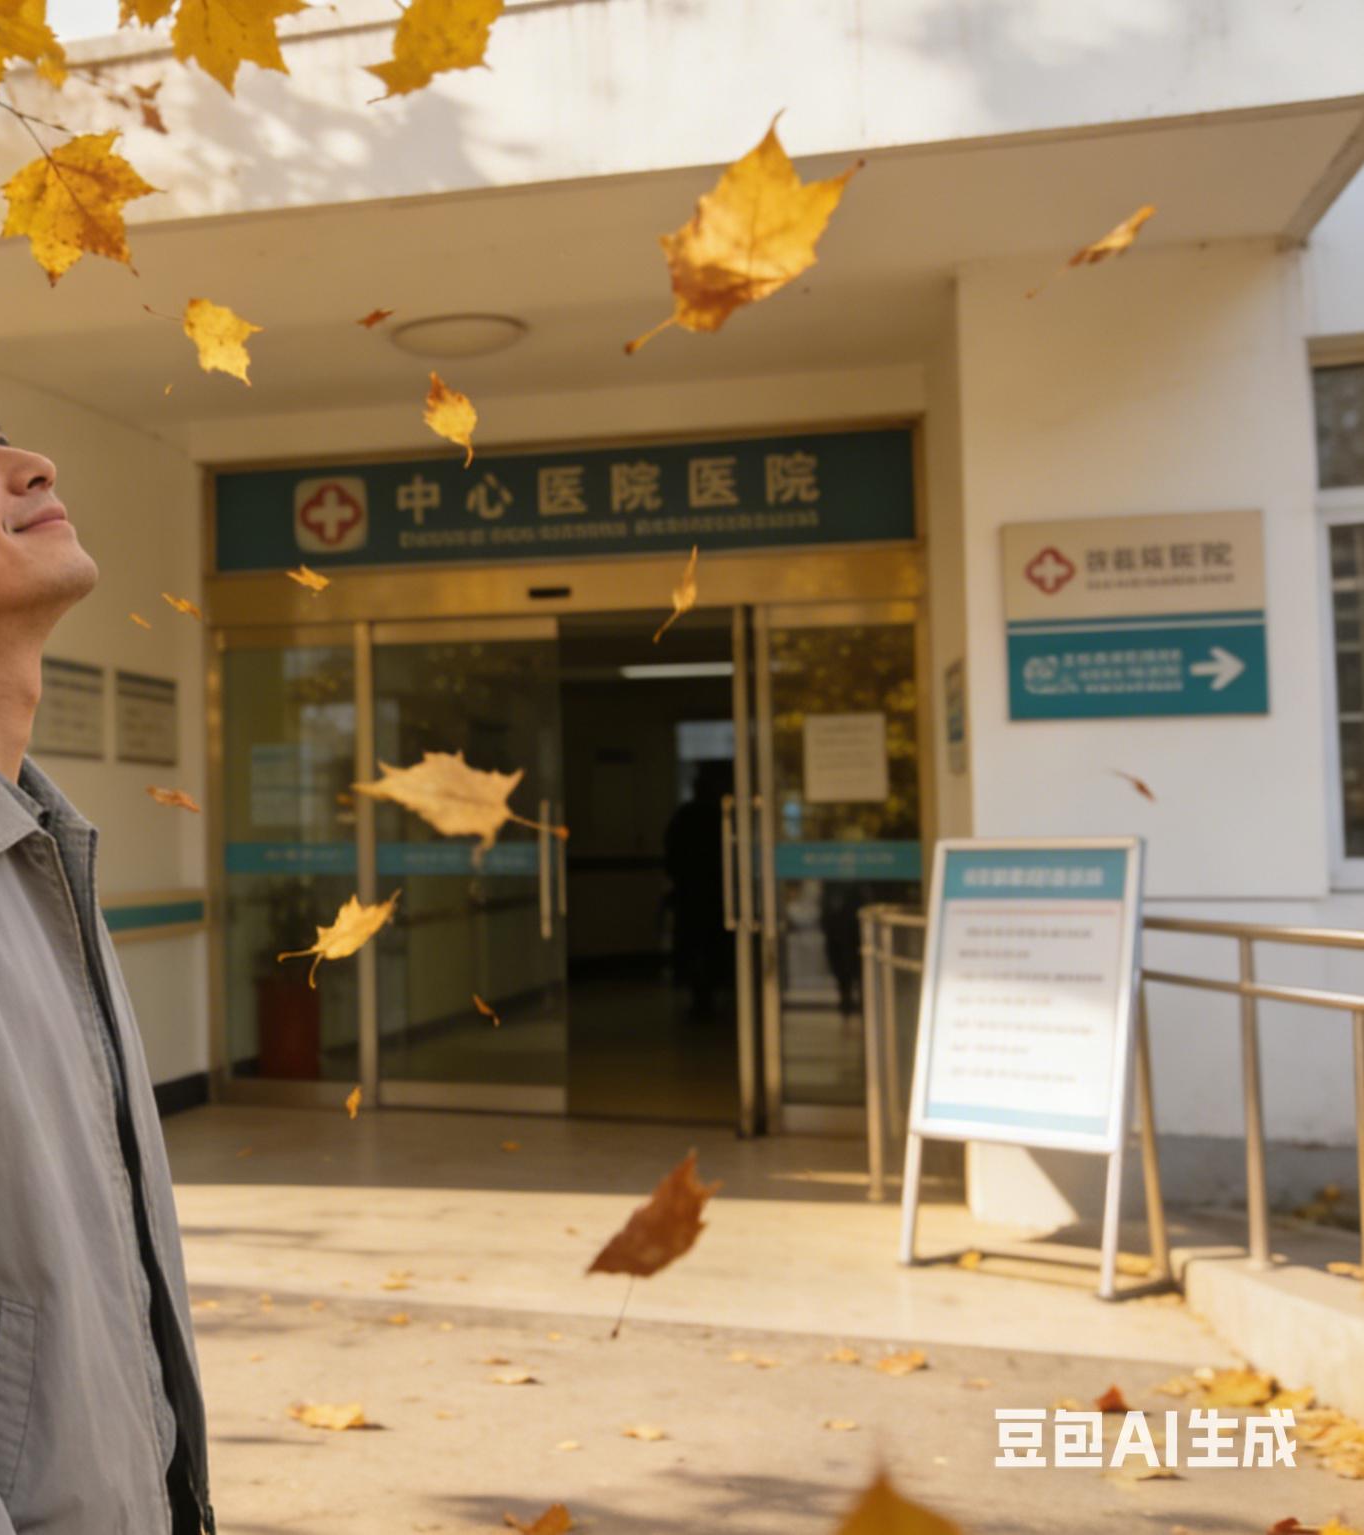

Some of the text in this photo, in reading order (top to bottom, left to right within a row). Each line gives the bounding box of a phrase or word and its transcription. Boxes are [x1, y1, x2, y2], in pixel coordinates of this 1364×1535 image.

[396, 452, 821, 525] 中心医院医院
